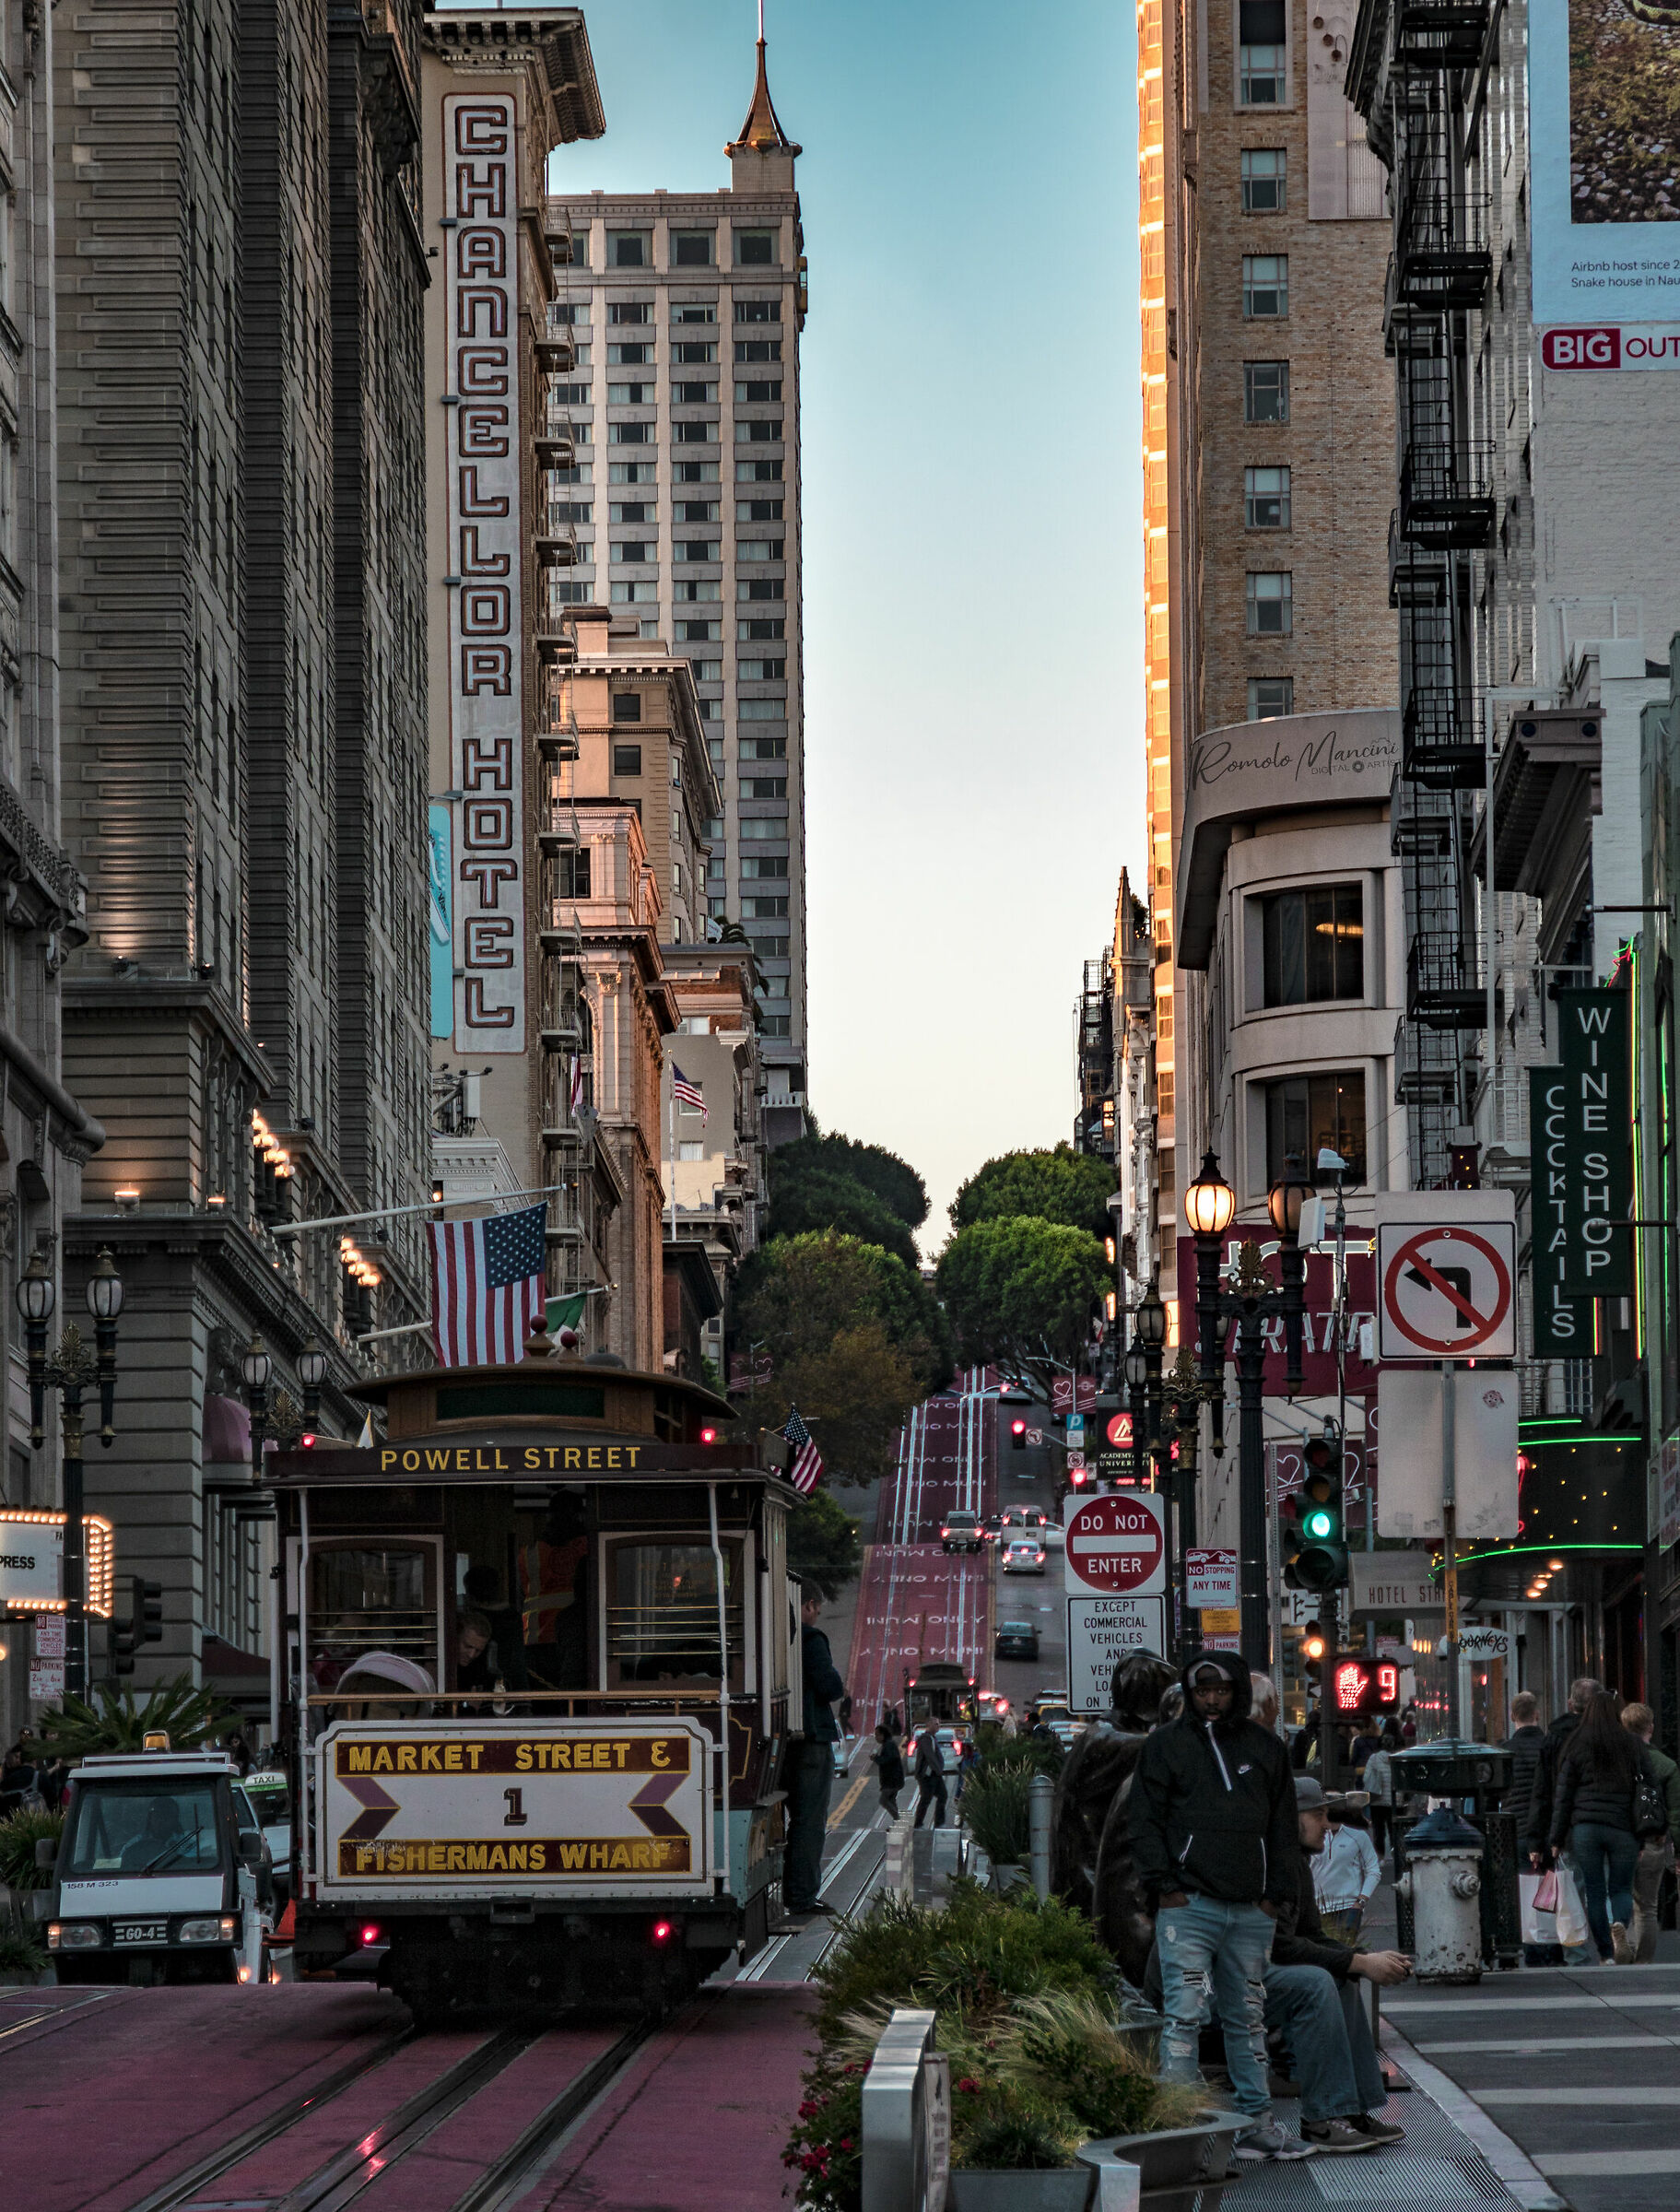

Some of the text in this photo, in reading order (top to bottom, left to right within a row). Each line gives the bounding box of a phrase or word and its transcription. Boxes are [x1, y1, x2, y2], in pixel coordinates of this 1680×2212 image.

[1571, 262, 1610, 272] Airbnb
[1613, 261, 1638, 271] host
[1640, 260, 1670, 270] since
[1571, 277, 1605, 288] Snake
[1608, 276, 1642, 287] house
[1645, 276, 1655, 286] in
[1554, 335, 1612, 364] BIG
[454, 105, 518, 1028] CHANCELLOR HOTEL
[1578, 1007, 1613, 1277] WINE SHOP
[381, 1446, 641, 1472] POWELL STREET
[1081, 1514, 1148, 1531] DO NOT
[1087, 1558, 1142, 1574] ENTER
[1189, 1566, 1204, 1575] NO
[1192, 1581, 1231, 1591] ANY TIME
[1369, 1586, 1407, 1604] HOTEL
[1095, 1601, 1136, 1613] EXCEPT
[1084, 1617, 1147, 1629] COMMERCIAL
[1090, 1633, 1143, 1644] VEHICLES
[1204, 1640, 1214, 1650] NO
[1459, 1630, 1509, 1653] OURNEYS
[1091, 1665, 1115, 1677] VEHI
[1381, 1669, 1396, 1700] 9
[1086, 1698, 1099, 1708] ON
[348, 1745, 484, 1771] MARKET
[515, 1743, 630, 1771] STREET
[253, 1775, 275, 1784] TAXI
[503, 1787, 528, 1827] 1
[356, 1842, 672, 1872] FISHERMANS WHARF
[125, 1926, 155, 1941] GO-4
